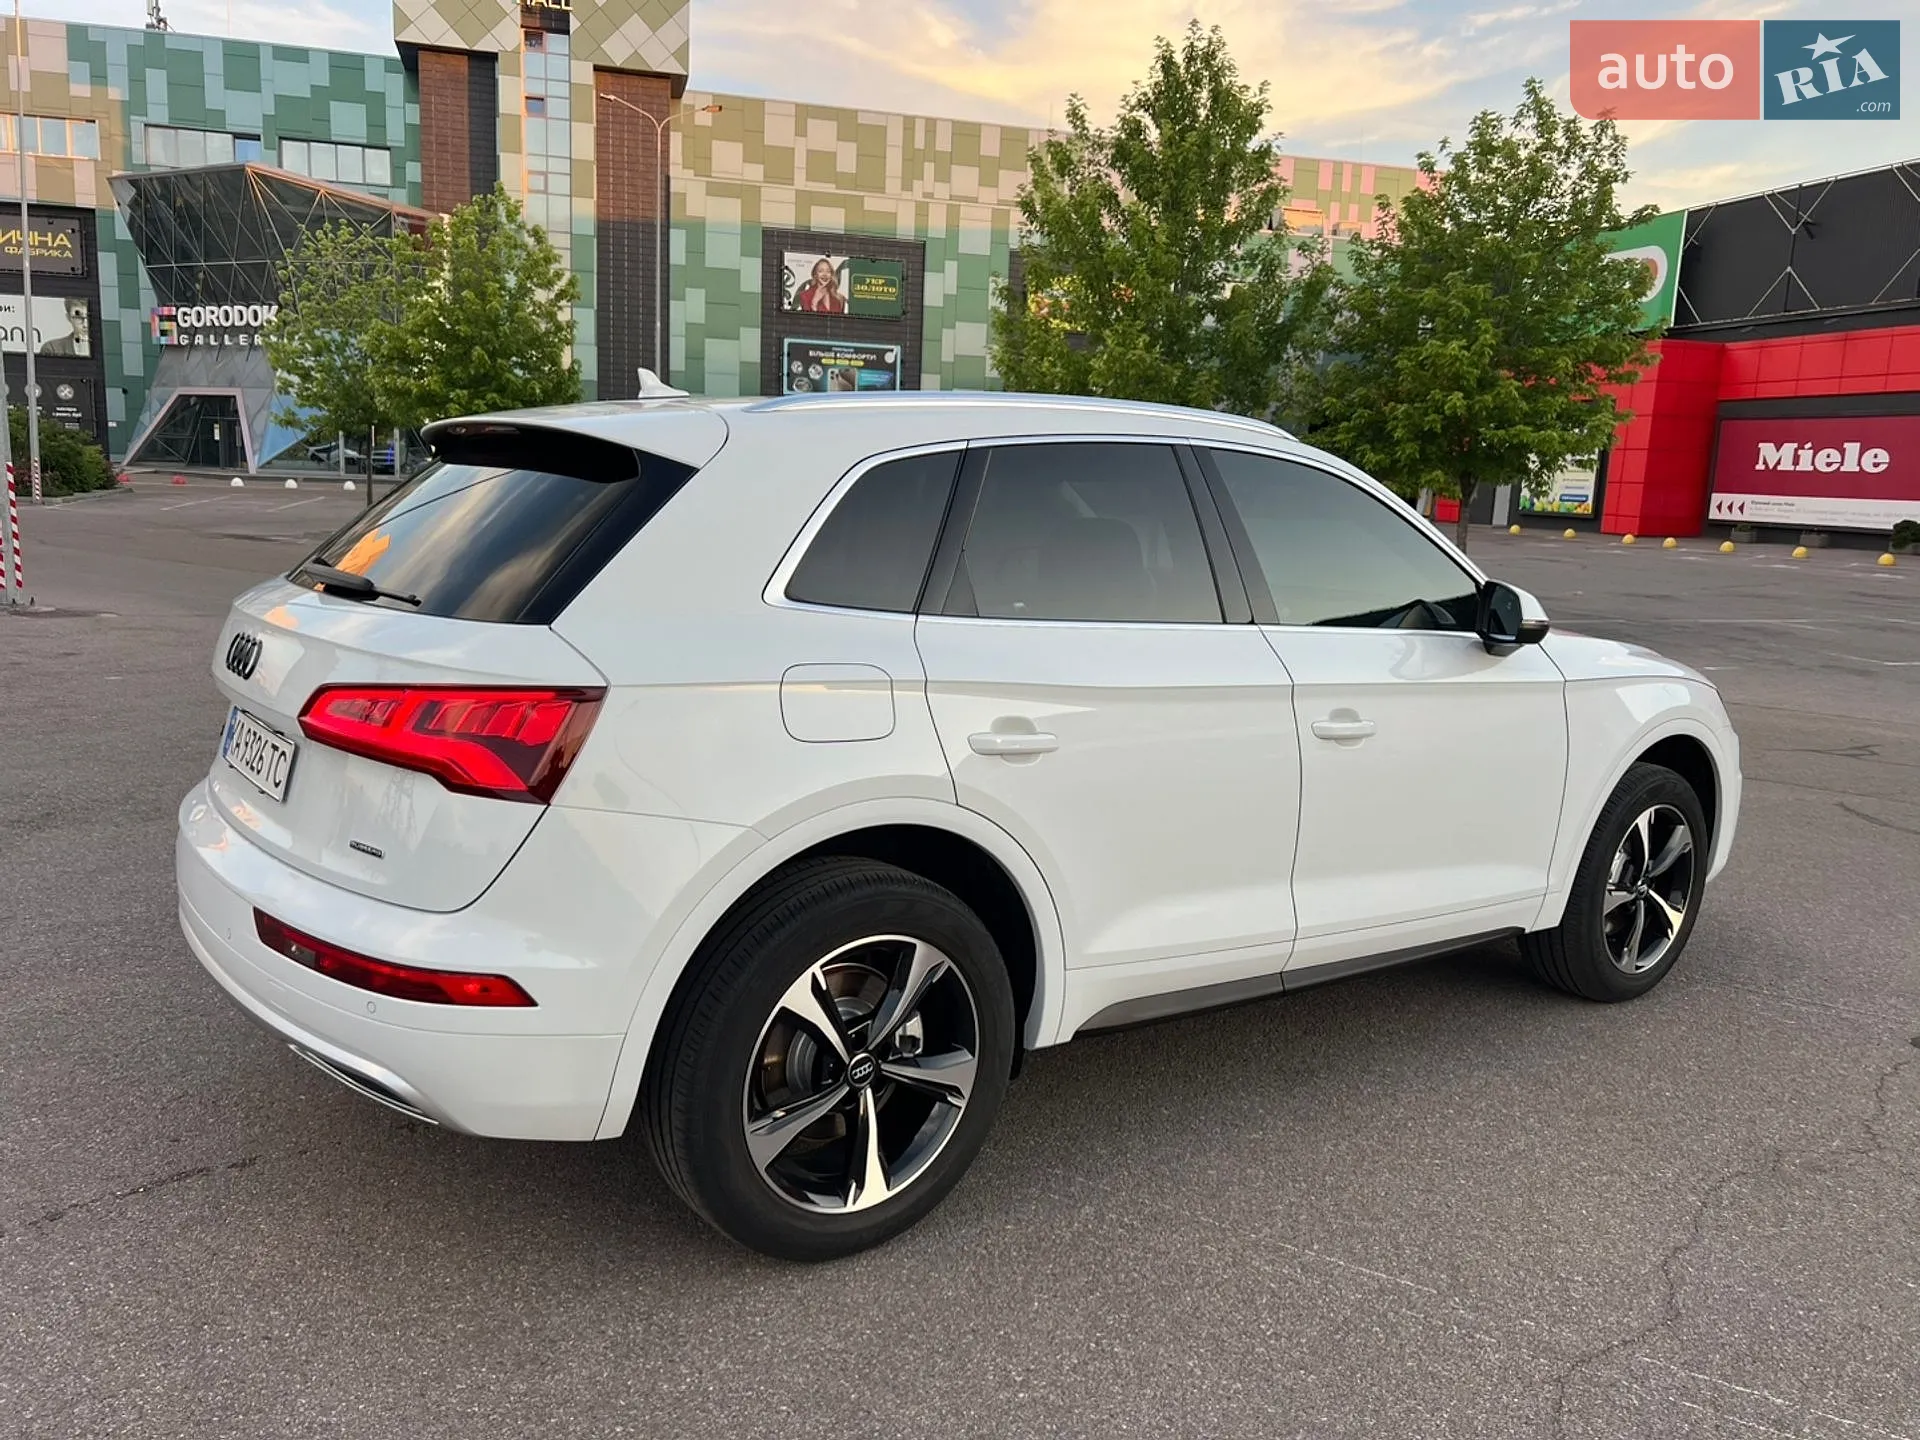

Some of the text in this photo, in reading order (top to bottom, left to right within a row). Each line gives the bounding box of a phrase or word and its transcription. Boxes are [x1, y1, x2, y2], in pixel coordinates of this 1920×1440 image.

[177, 305, 279, 328] GORODOK
[179, 334, 277, 345] GALLER
[1755, 441, 1890, 473] Miele
